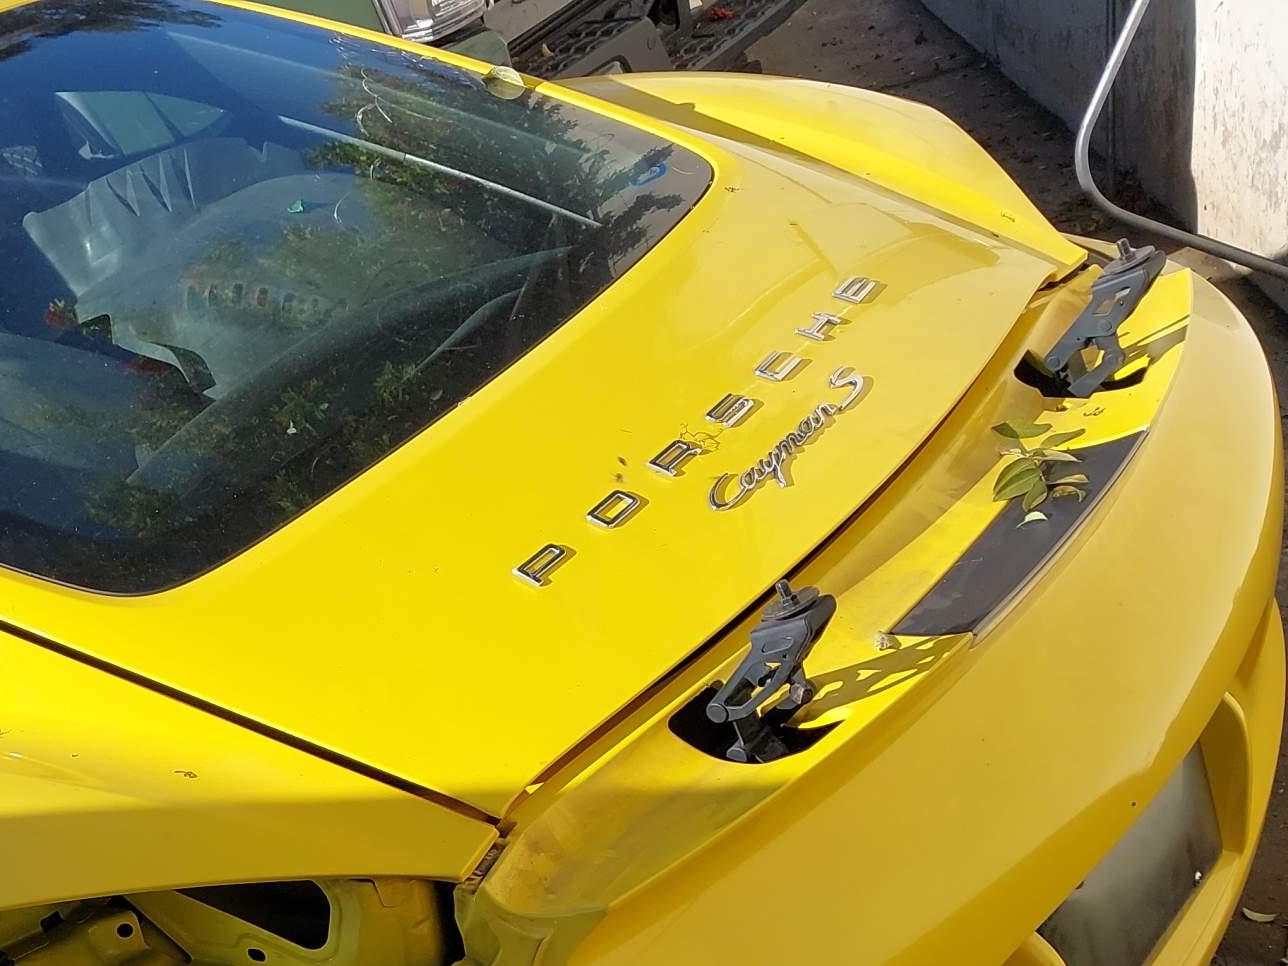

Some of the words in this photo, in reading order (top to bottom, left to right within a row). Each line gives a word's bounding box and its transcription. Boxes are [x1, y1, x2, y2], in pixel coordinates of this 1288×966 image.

[512, 276, 878, 587] PORSCHE
[709, 403, 839, 511] Cayman
[829, 366, 865, 412] S
